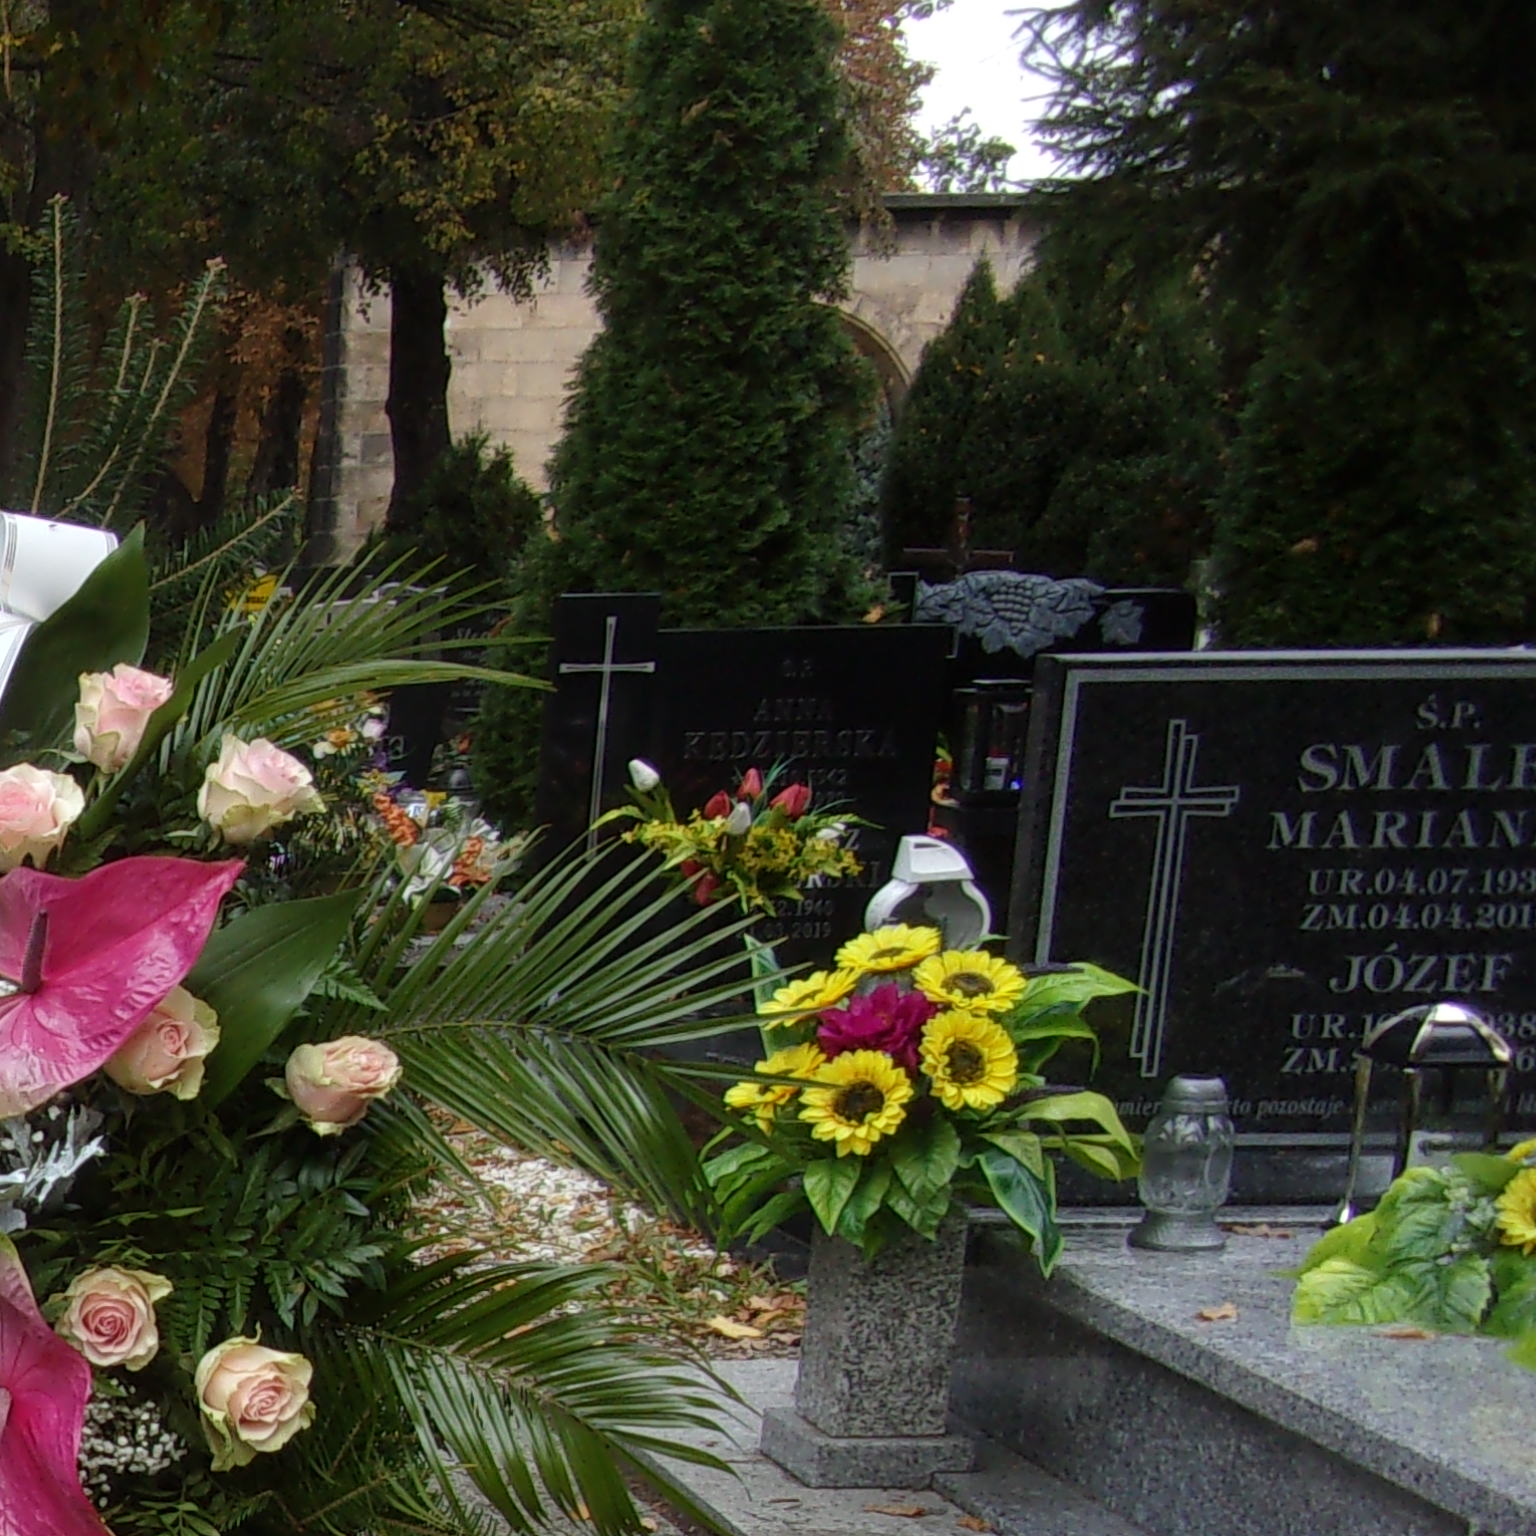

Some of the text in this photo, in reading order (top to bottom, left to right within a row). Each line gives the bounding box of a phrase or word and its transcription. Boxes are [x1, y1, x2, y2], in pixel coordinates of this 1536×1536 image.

[1416, 692, 1482, 730] Ś.P.
[1266, 809, 1536, 849] MARIAN
[1328, 942, 1514, 994] JÓZEF
